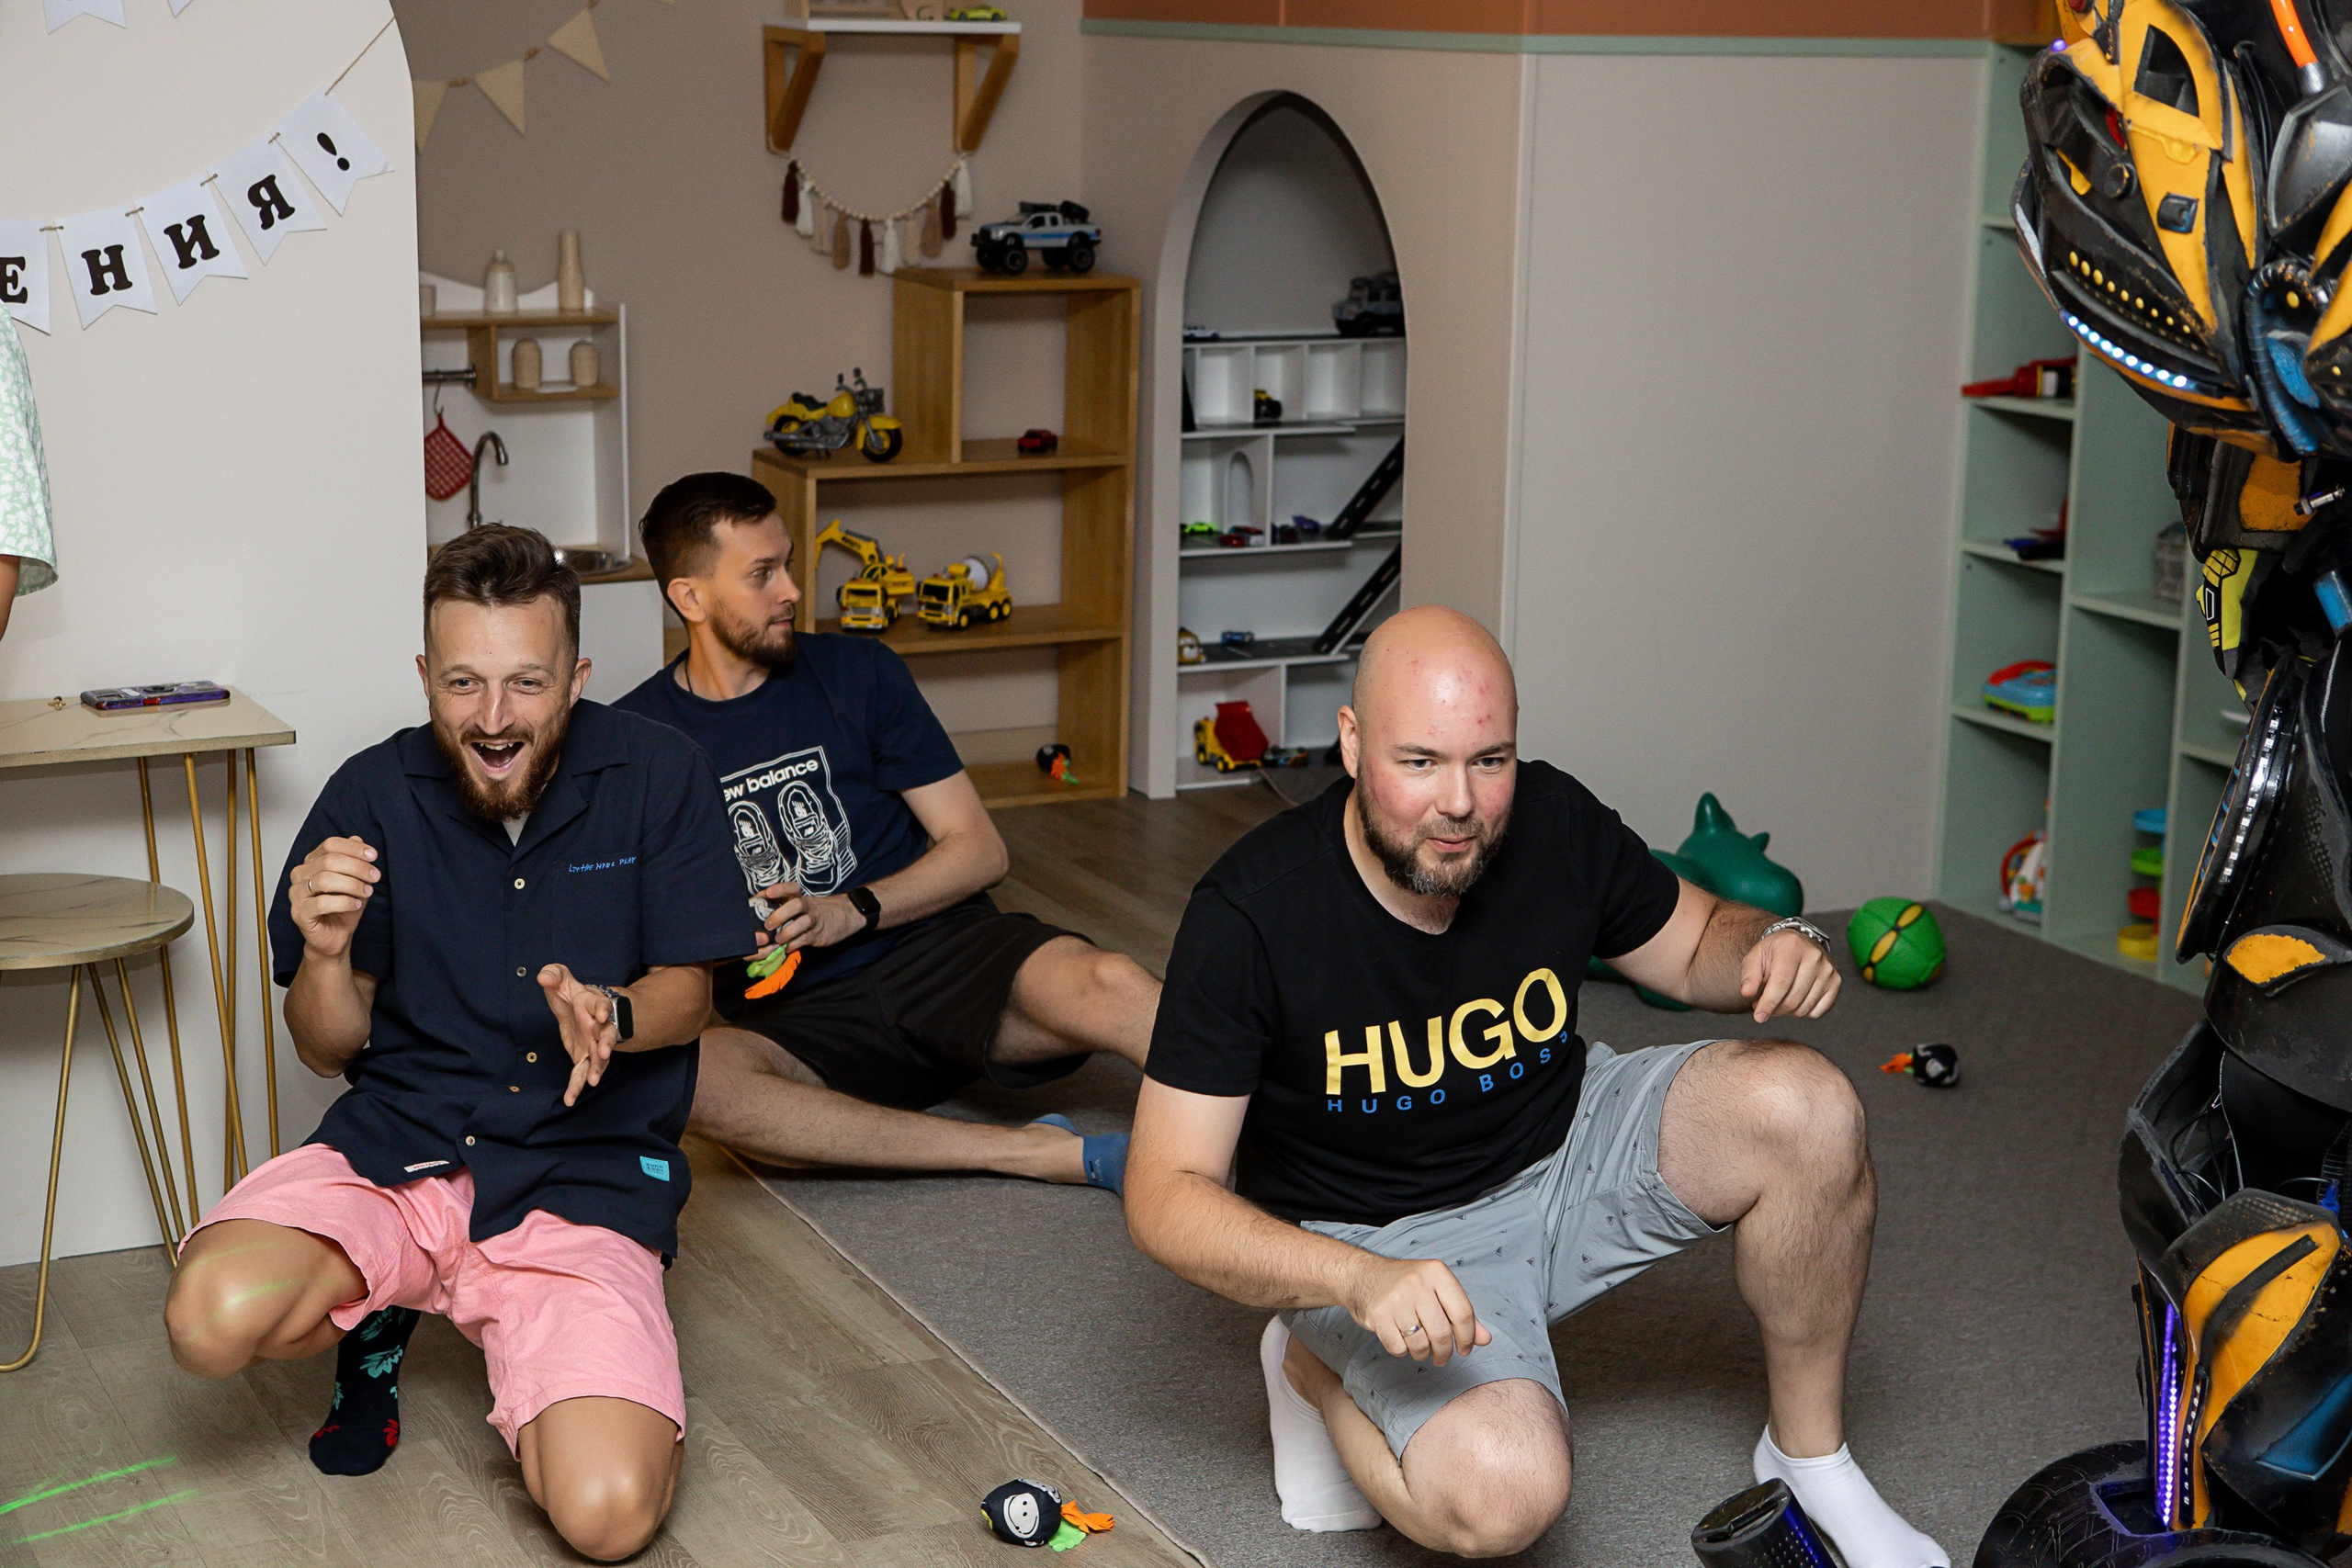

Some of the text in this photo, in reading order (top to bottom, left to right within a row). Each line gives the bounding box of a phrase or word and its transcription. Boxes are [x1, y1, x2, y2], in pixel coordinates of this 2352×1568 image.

[746, 759, 819, 794] balance
[618, 856, 637, 866] PLAY
[1324, 967, 1567, 1096] HUGO
[1327, 1089, 1446, 1114] HUGO
